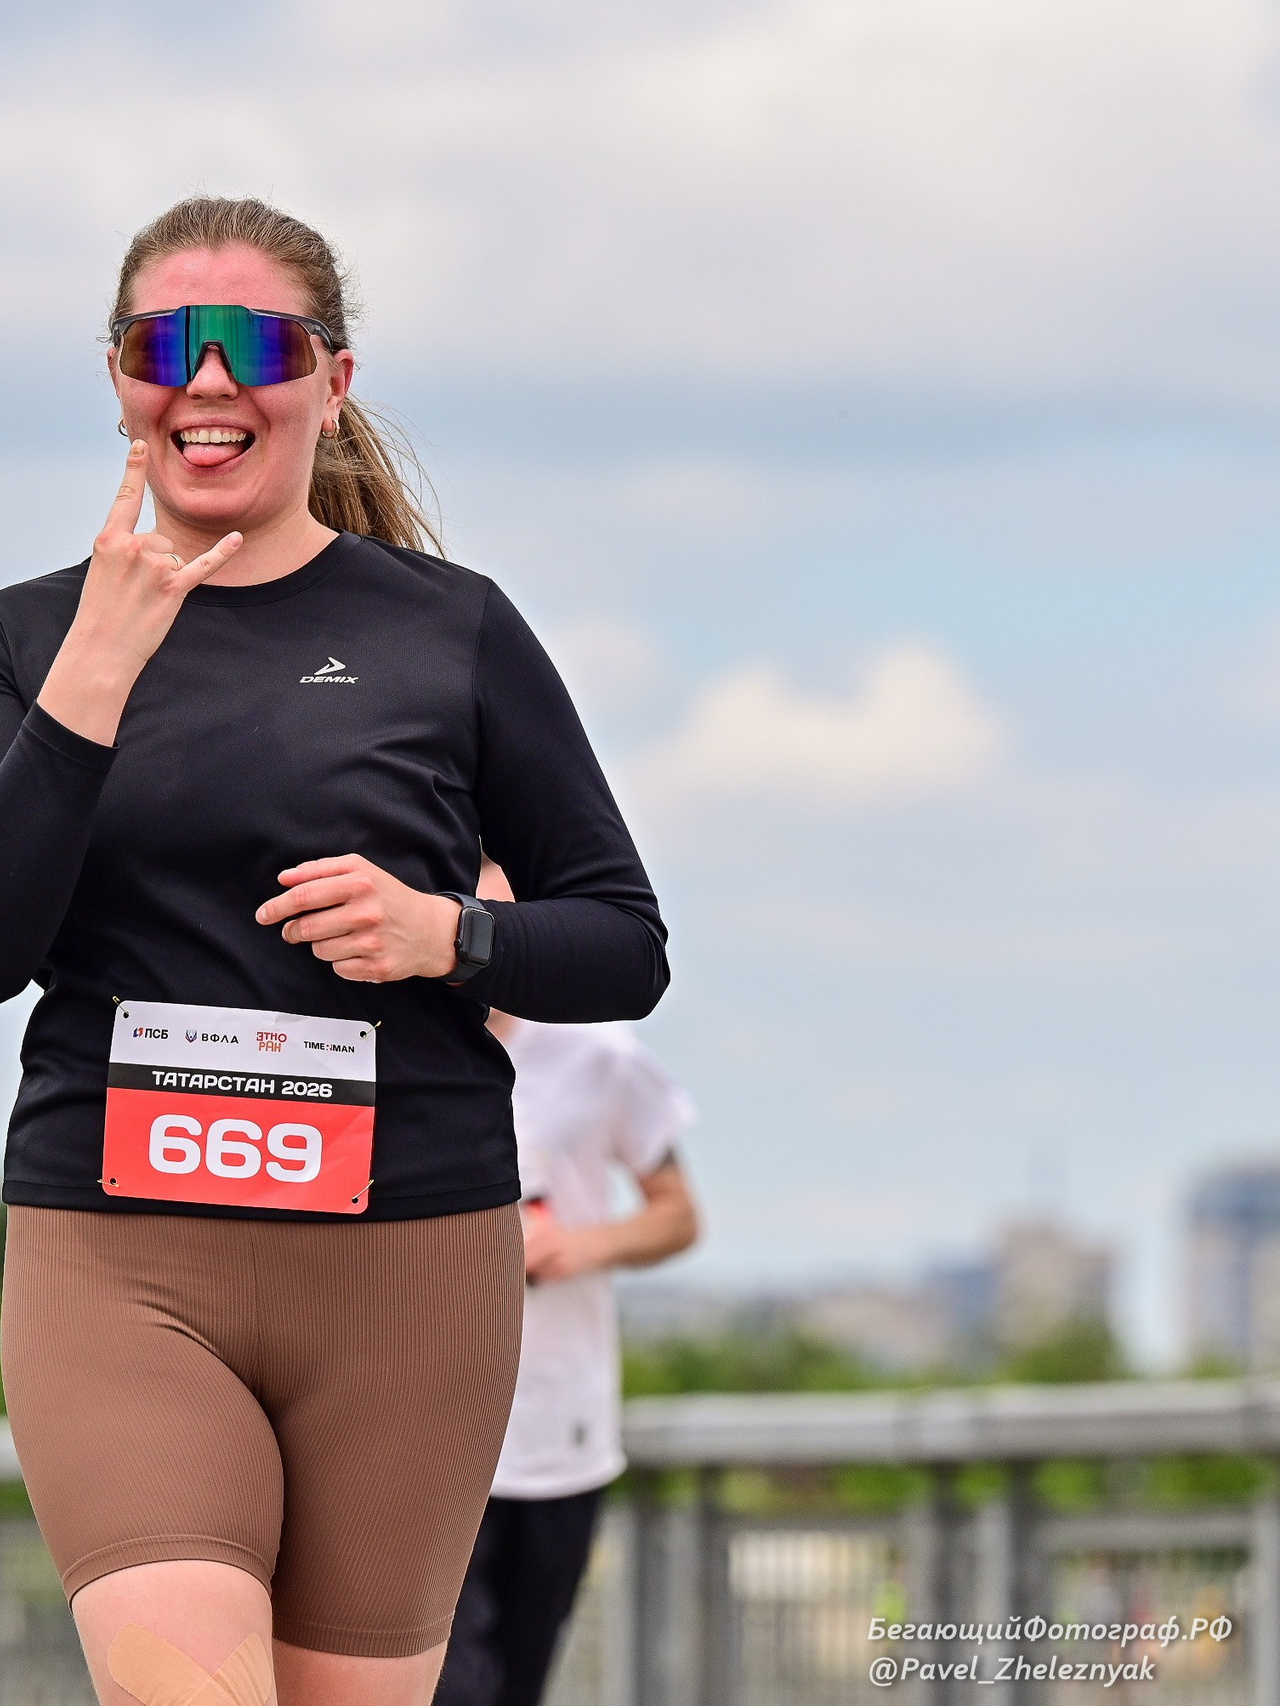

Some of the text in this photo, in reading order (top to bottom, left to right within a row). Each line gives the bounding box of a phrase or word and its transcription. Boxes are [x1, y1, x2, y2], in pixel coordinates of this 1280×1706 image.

[300, 676, 358, 684] DEMIX
[144, 1028, 169, 1040] ПСБ
[201, 1033, 239, 1044] ВФЛА
[152, 1070, 333, 1098] ТАТАРСТАН 2026
[148, 1114, 323, 1183] 669
